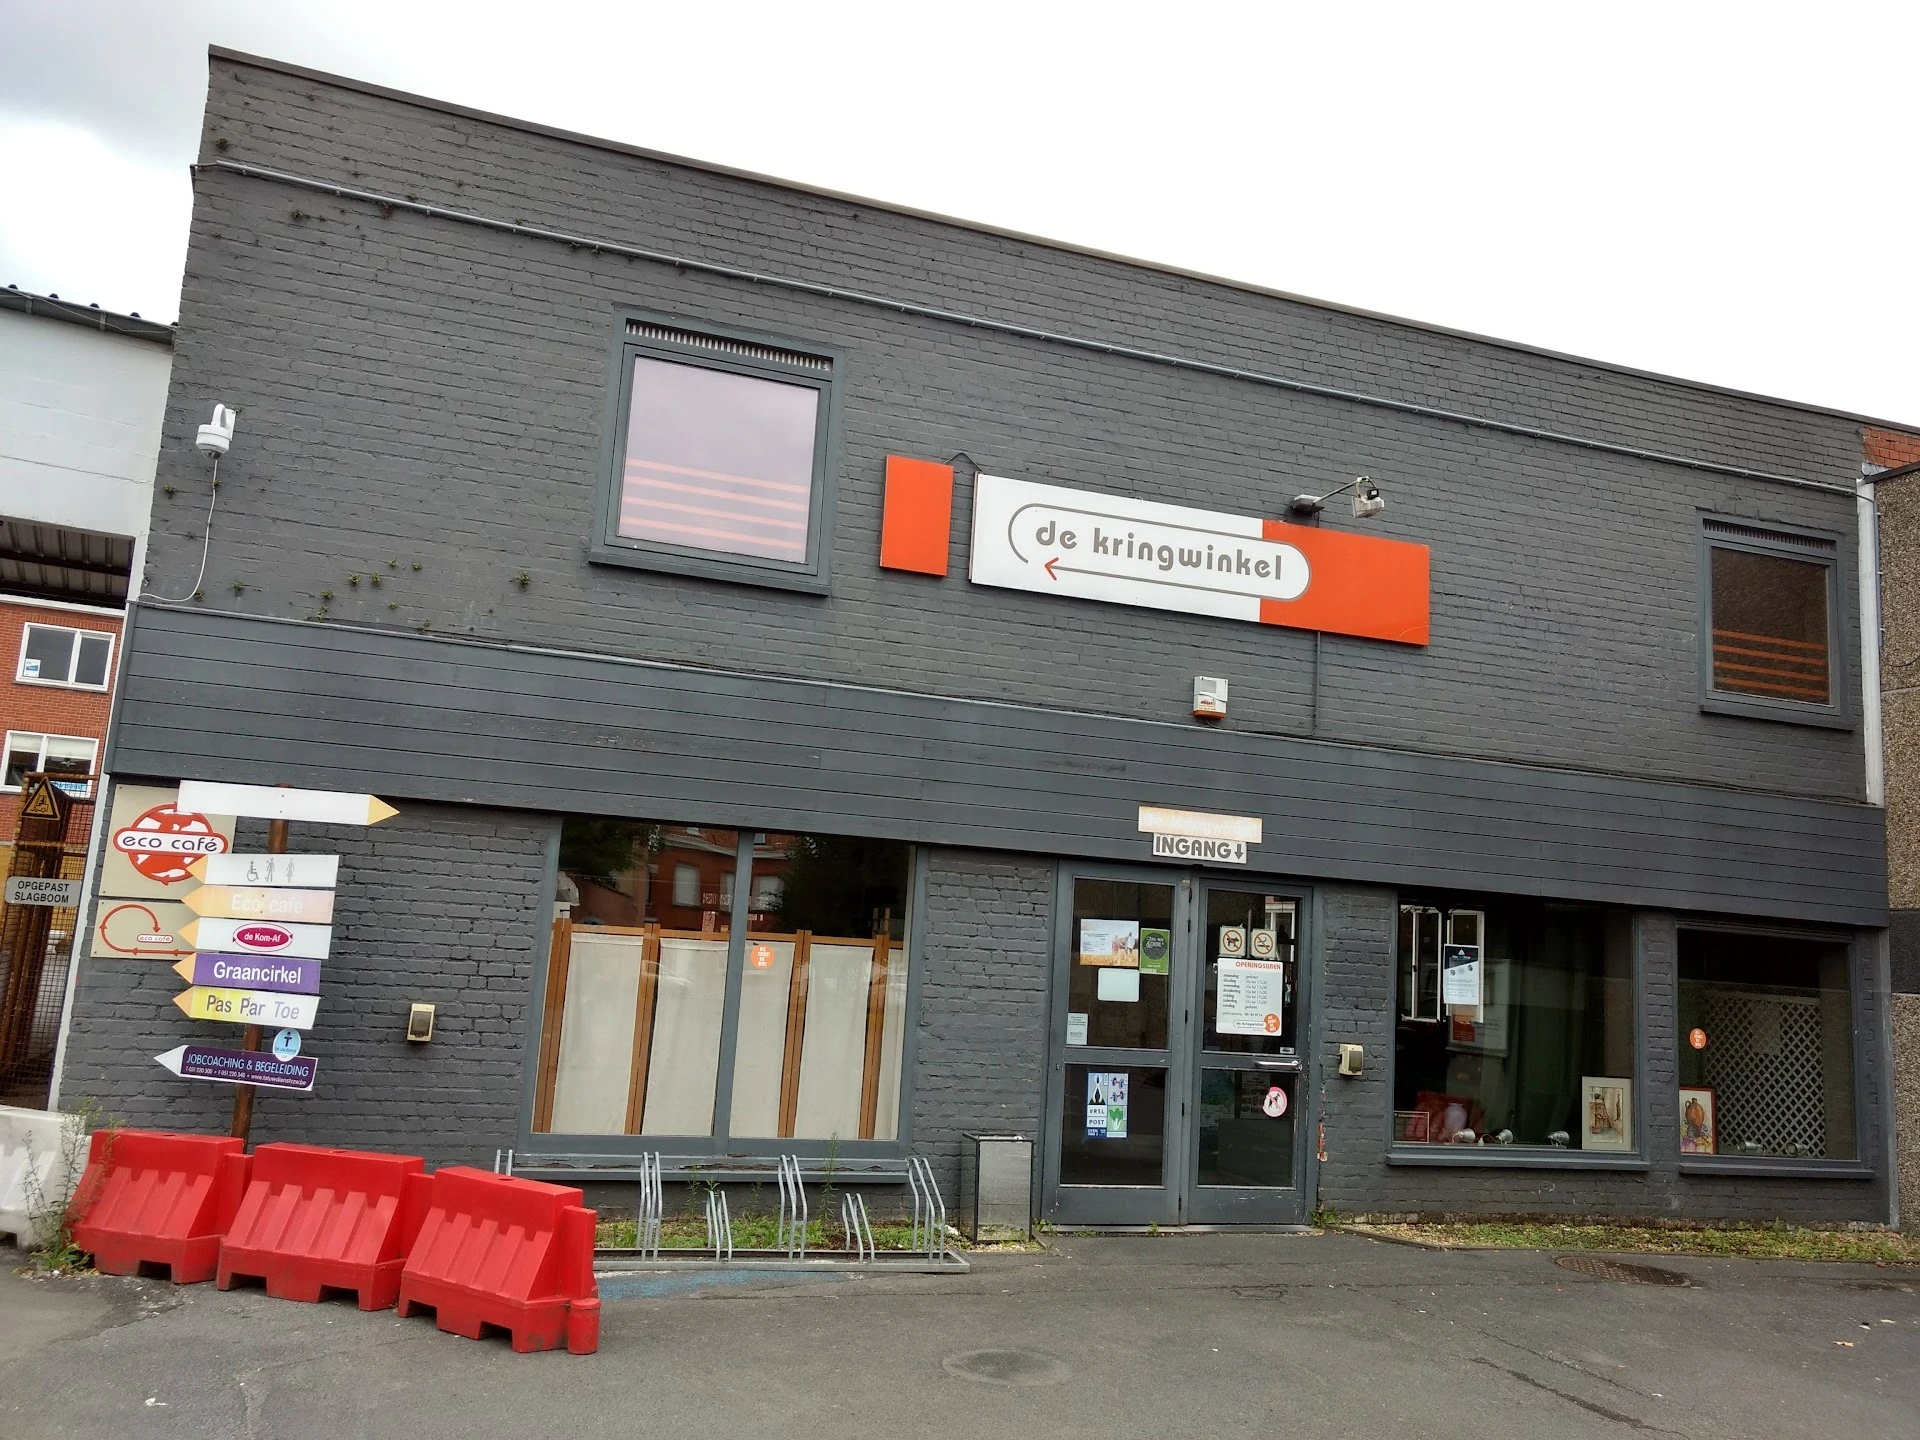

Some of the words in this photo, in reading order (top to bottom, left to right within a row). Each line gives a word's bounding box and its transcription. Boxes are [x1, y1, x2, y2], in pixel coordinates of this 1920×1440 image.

[1036, 521, 1077, 549] de
[1094, 528, 1282, 580] kringwinkel
[123, 836, 162, 848] eco
[172, 838, 217, 851] café
[1156, 836, 1231, 858] INGANG
[18, 881, 69, 892] OPGEPAST
[15, 892, 68, 903] SLAGBOOM
[232, 894, 260, 911] Eco
[244, 932, 253, 940] de
[255, 933, 281, 942] Kom-Af
[214, 961, 301, 984] Graancirkel
[207, 995, 232, 1013] Pas
[240, 998, 266, 1016] Par
[274, 1001, 300, 1019] Toe
[186, 1054, 244, 1069] JOBCOACHING
[246, 1060, 253, 1070] &
[255, 1061, 309, 1076] BEGELEIDING
